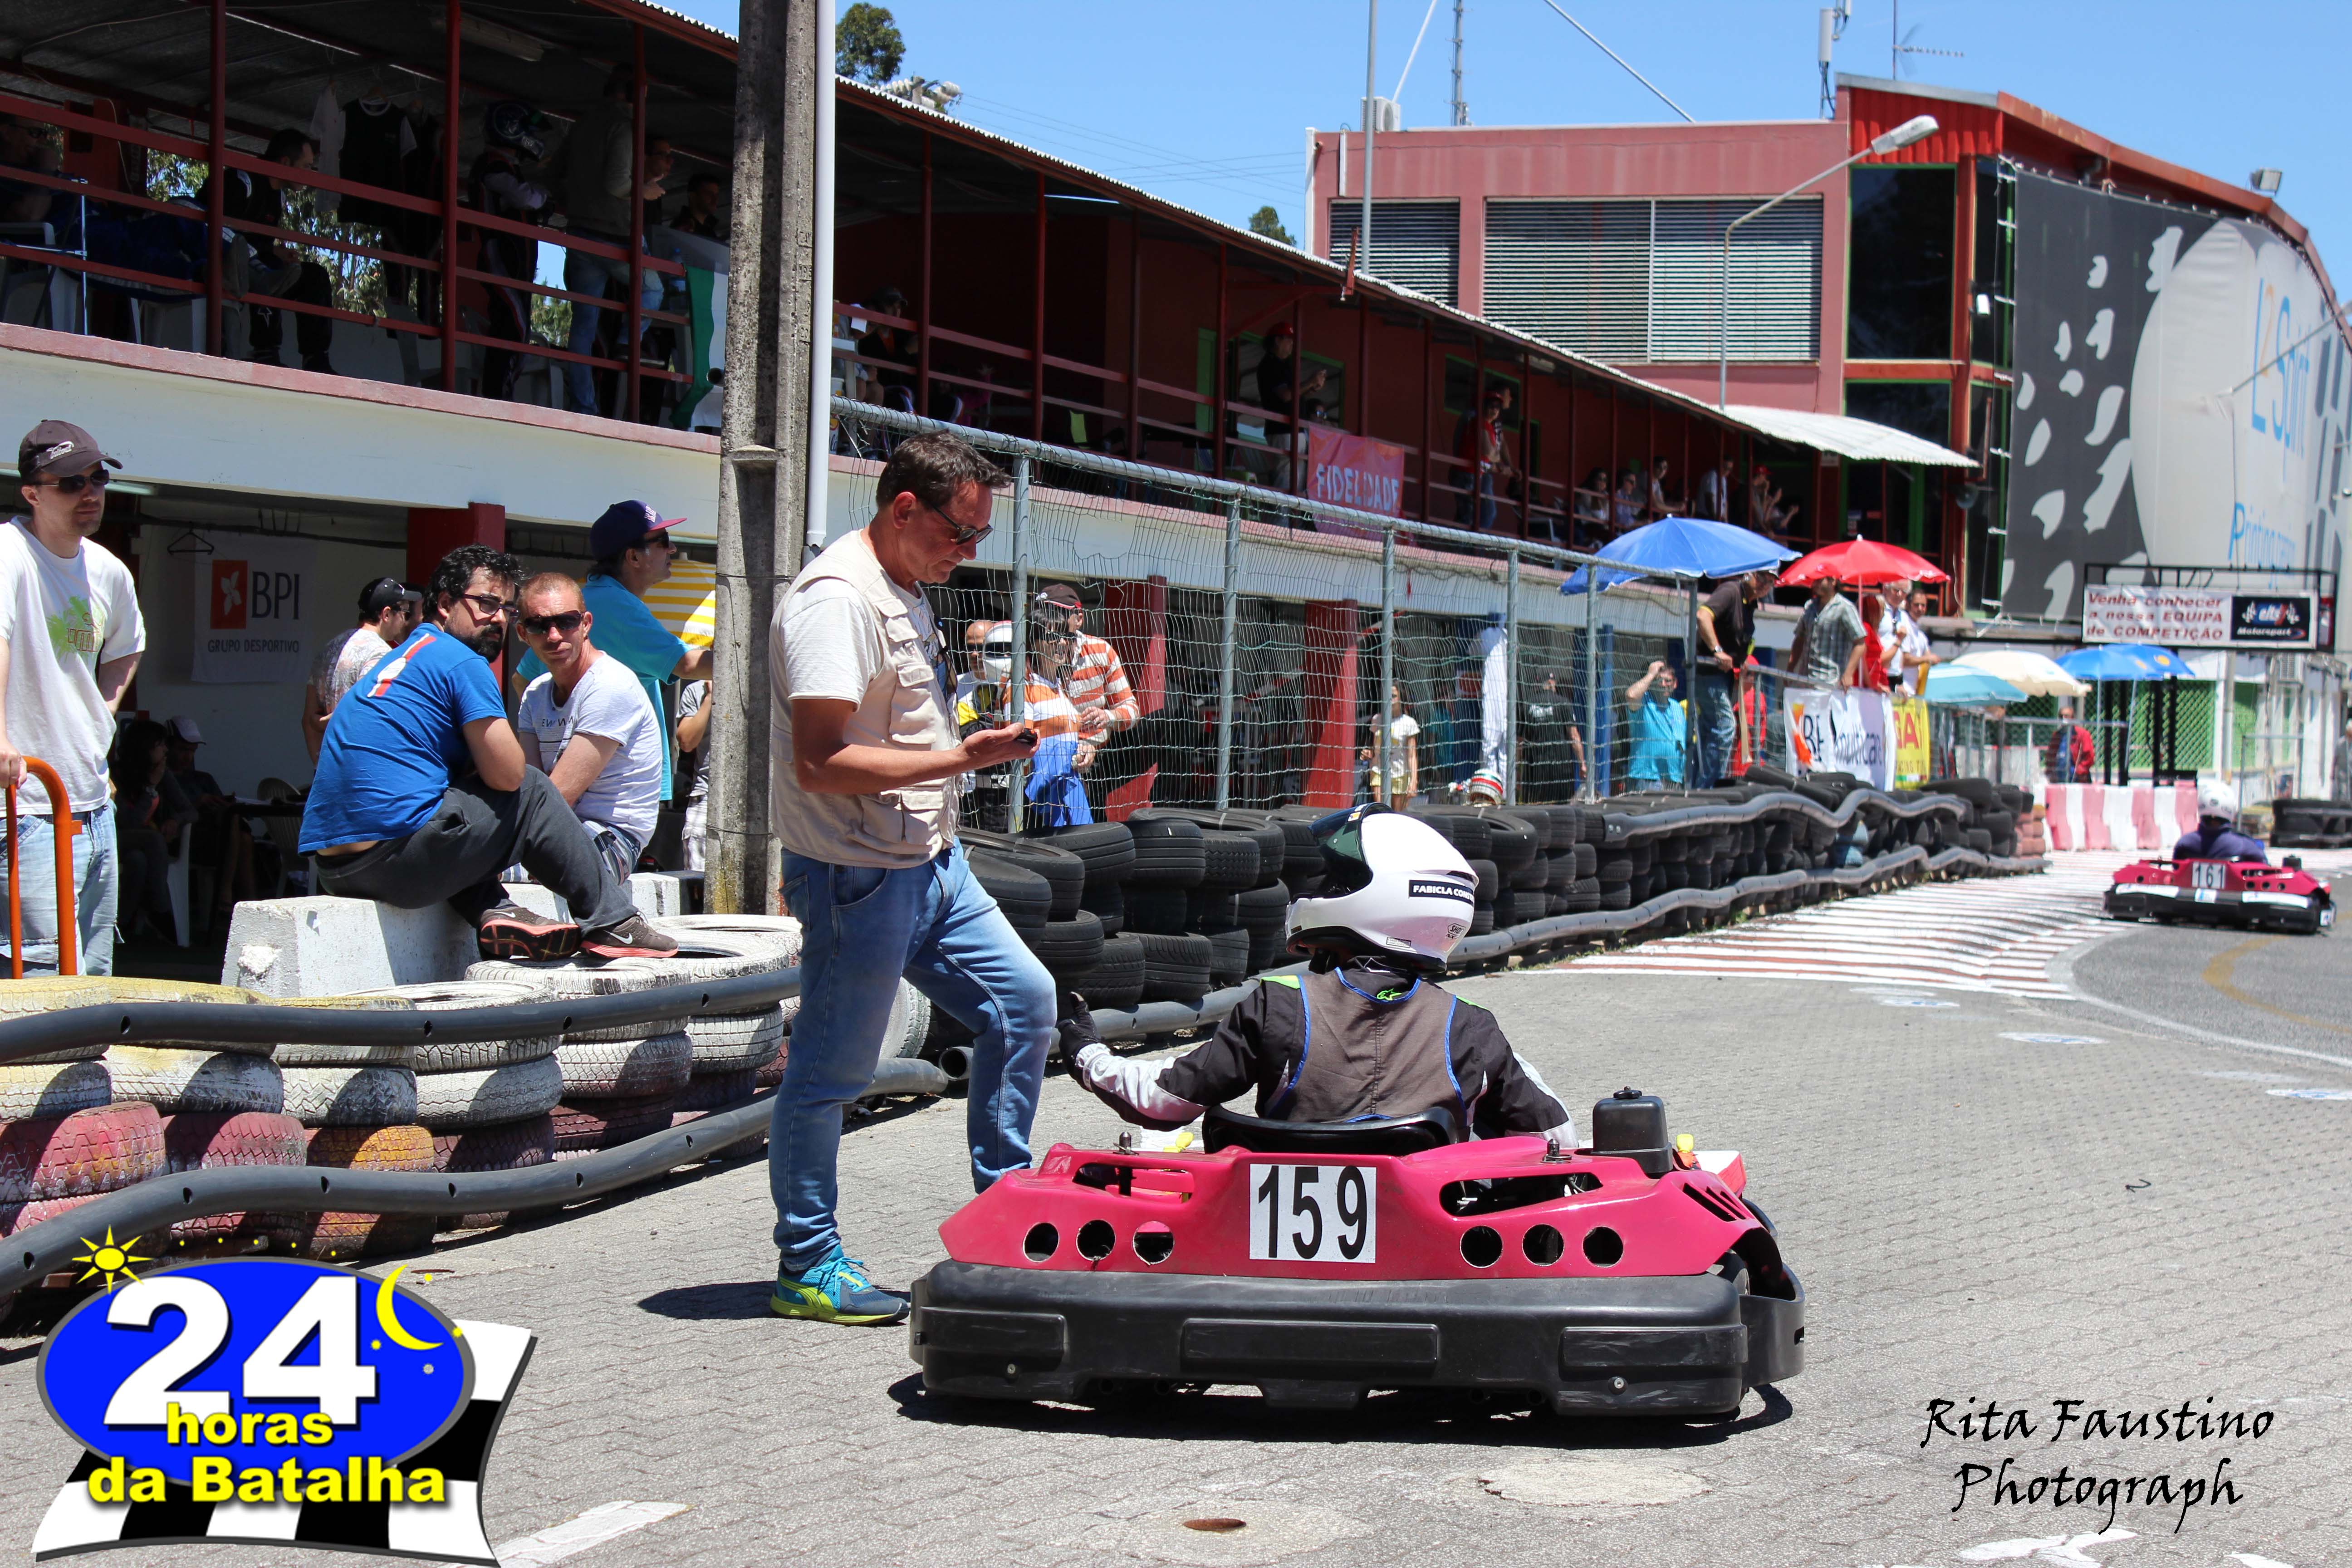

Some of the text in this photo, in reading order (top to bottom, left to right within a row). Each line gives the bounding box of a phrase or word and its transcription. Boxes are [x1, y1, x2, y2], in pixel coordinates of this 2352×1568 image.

[251, 571, 300, 620] BPI
[2089, 593, 2222, 607] Venha conhecer
[2106, 612, 2154, 621] nossa
[2162, 612, 2222, 622] EQUIPA
[2087, 625, 2104, 635] de
[208, 639, 299, 653] GRUPO DESPORTIVO
[2195, 864, 2224, 887] 161
[1413, 885, 1453, 895] FABICLA
[1259, 1164, 1367, 1260] 159
